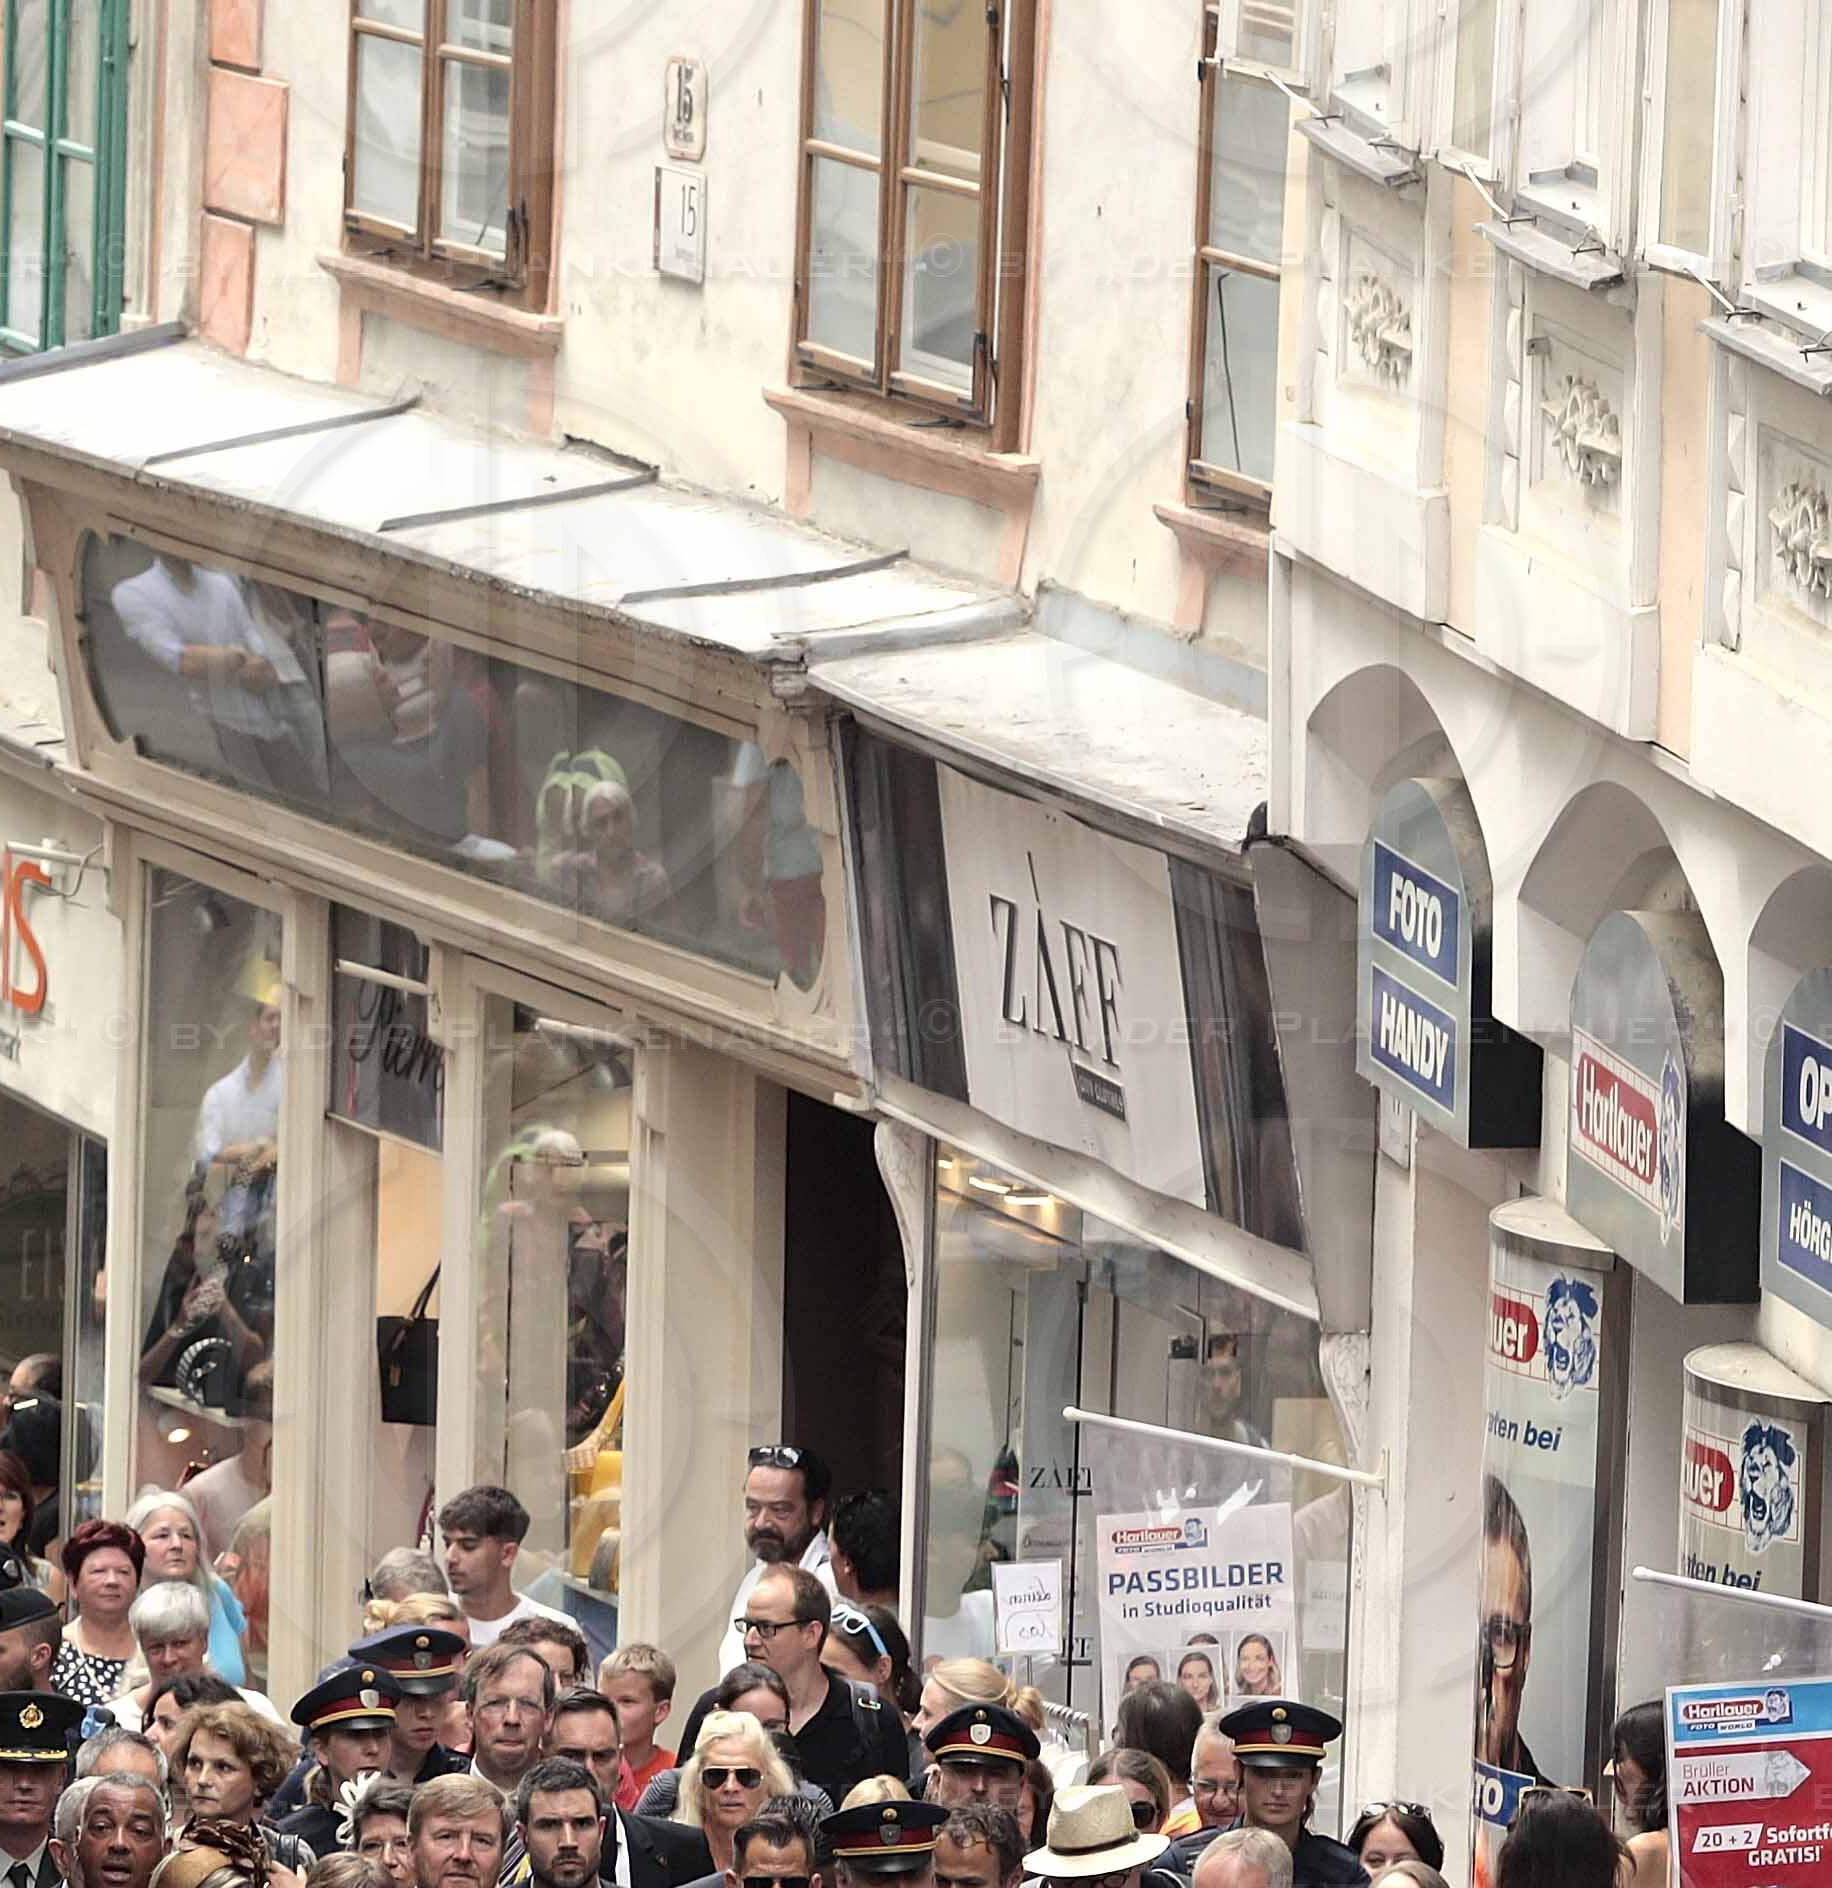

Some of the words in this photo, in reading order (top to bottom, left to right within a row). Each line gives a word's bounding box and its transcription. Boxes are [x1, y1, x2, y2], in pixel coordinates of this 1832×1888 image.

[1389, 873, 1442, 958] FOTO
[1381, 991, 1448, 1089] HANDY
[1582, 1058, 1653, 1178] Hartlauer
[1523, 1420, 1562, 1451] bei
[1117, 1527, 1180, 1544] Hartlauer
[1108, 1562, 1284, 1596] PASSBILDER
[1123, 1603, 1139, 1619] in
[1144, 1593, 1272, 1618] Studioqualität
[1687, 1701, 1760, 1720] Hartlauer
[1683, 1777, 1755, 1797] AKTION
[1701, 1832, 1723, 1848] 20
[1743, 1830, 1753, 1845] 2
